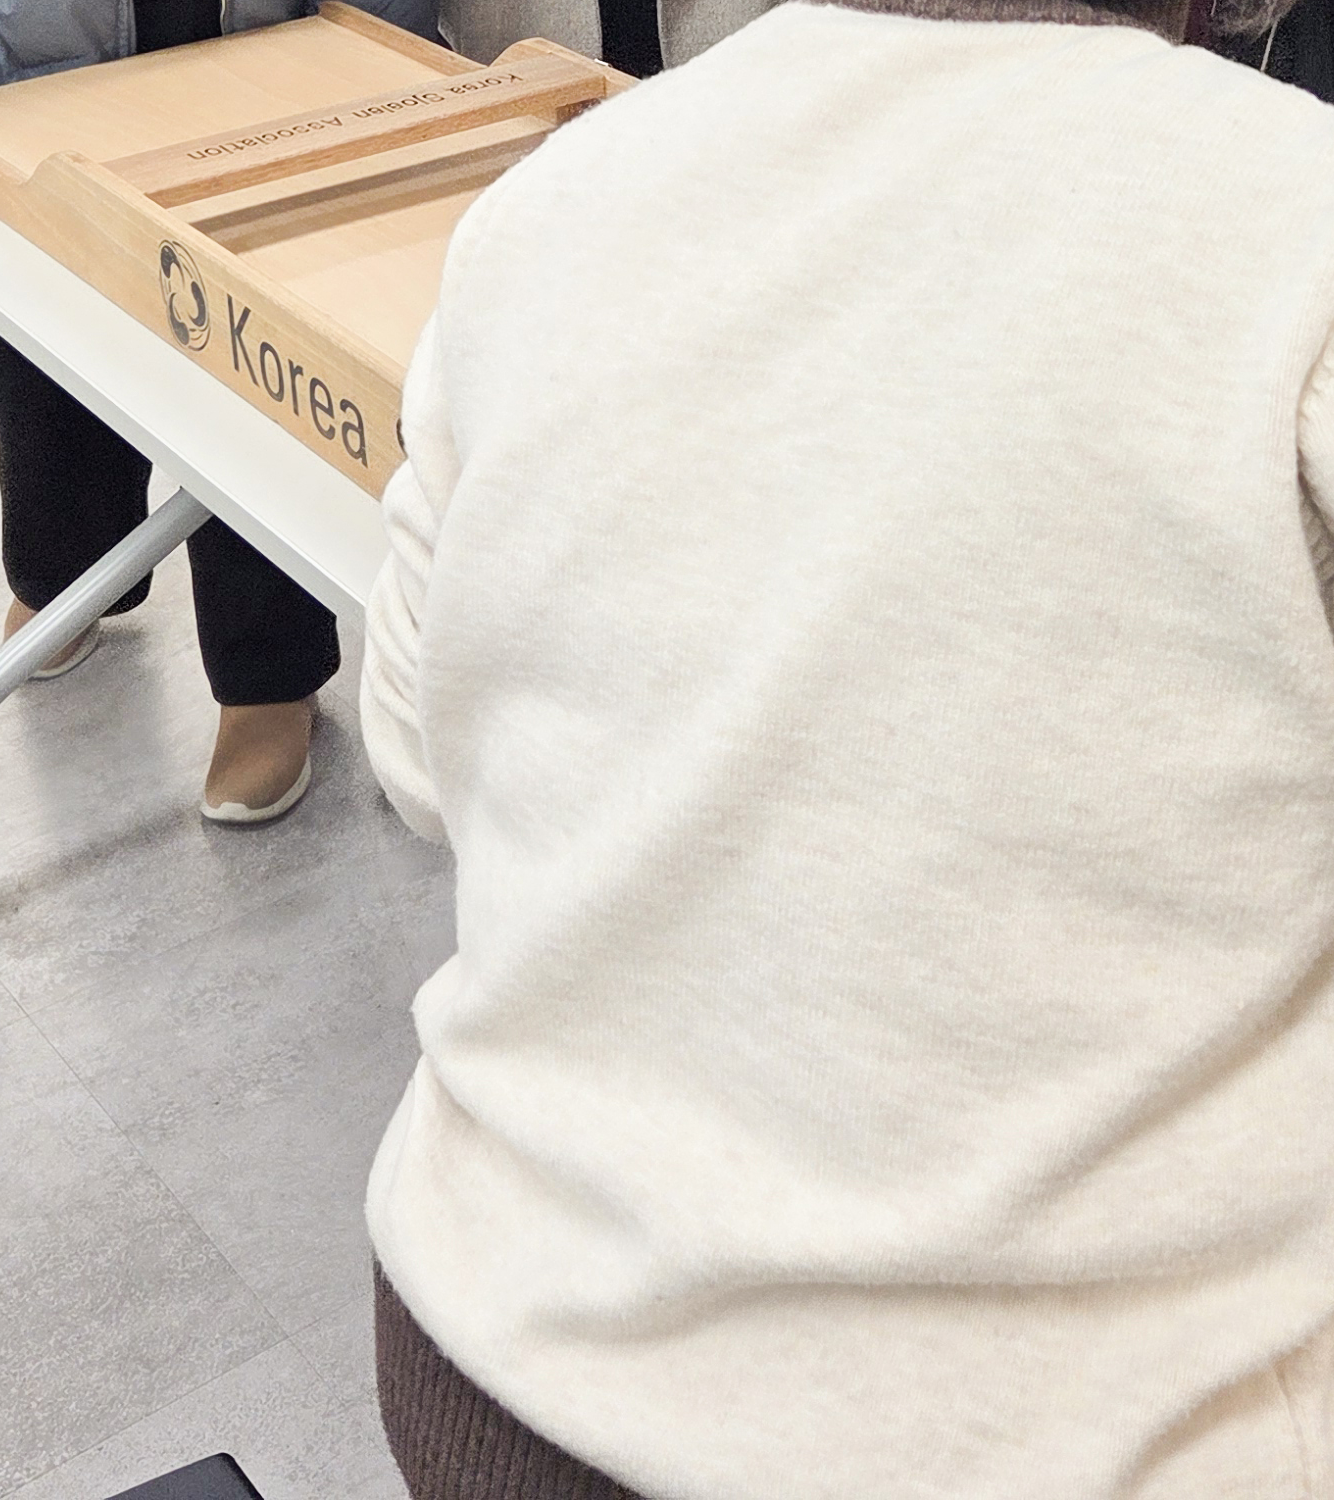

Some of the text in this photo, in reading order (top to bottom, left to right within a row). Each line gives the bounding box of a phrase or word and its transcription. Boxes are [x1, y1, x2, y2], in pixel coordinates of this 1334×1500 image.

[446, 72, 523, 97] Korea
[187, 115, 344, 162] Association
[226, 292, 369, 470] Korea
